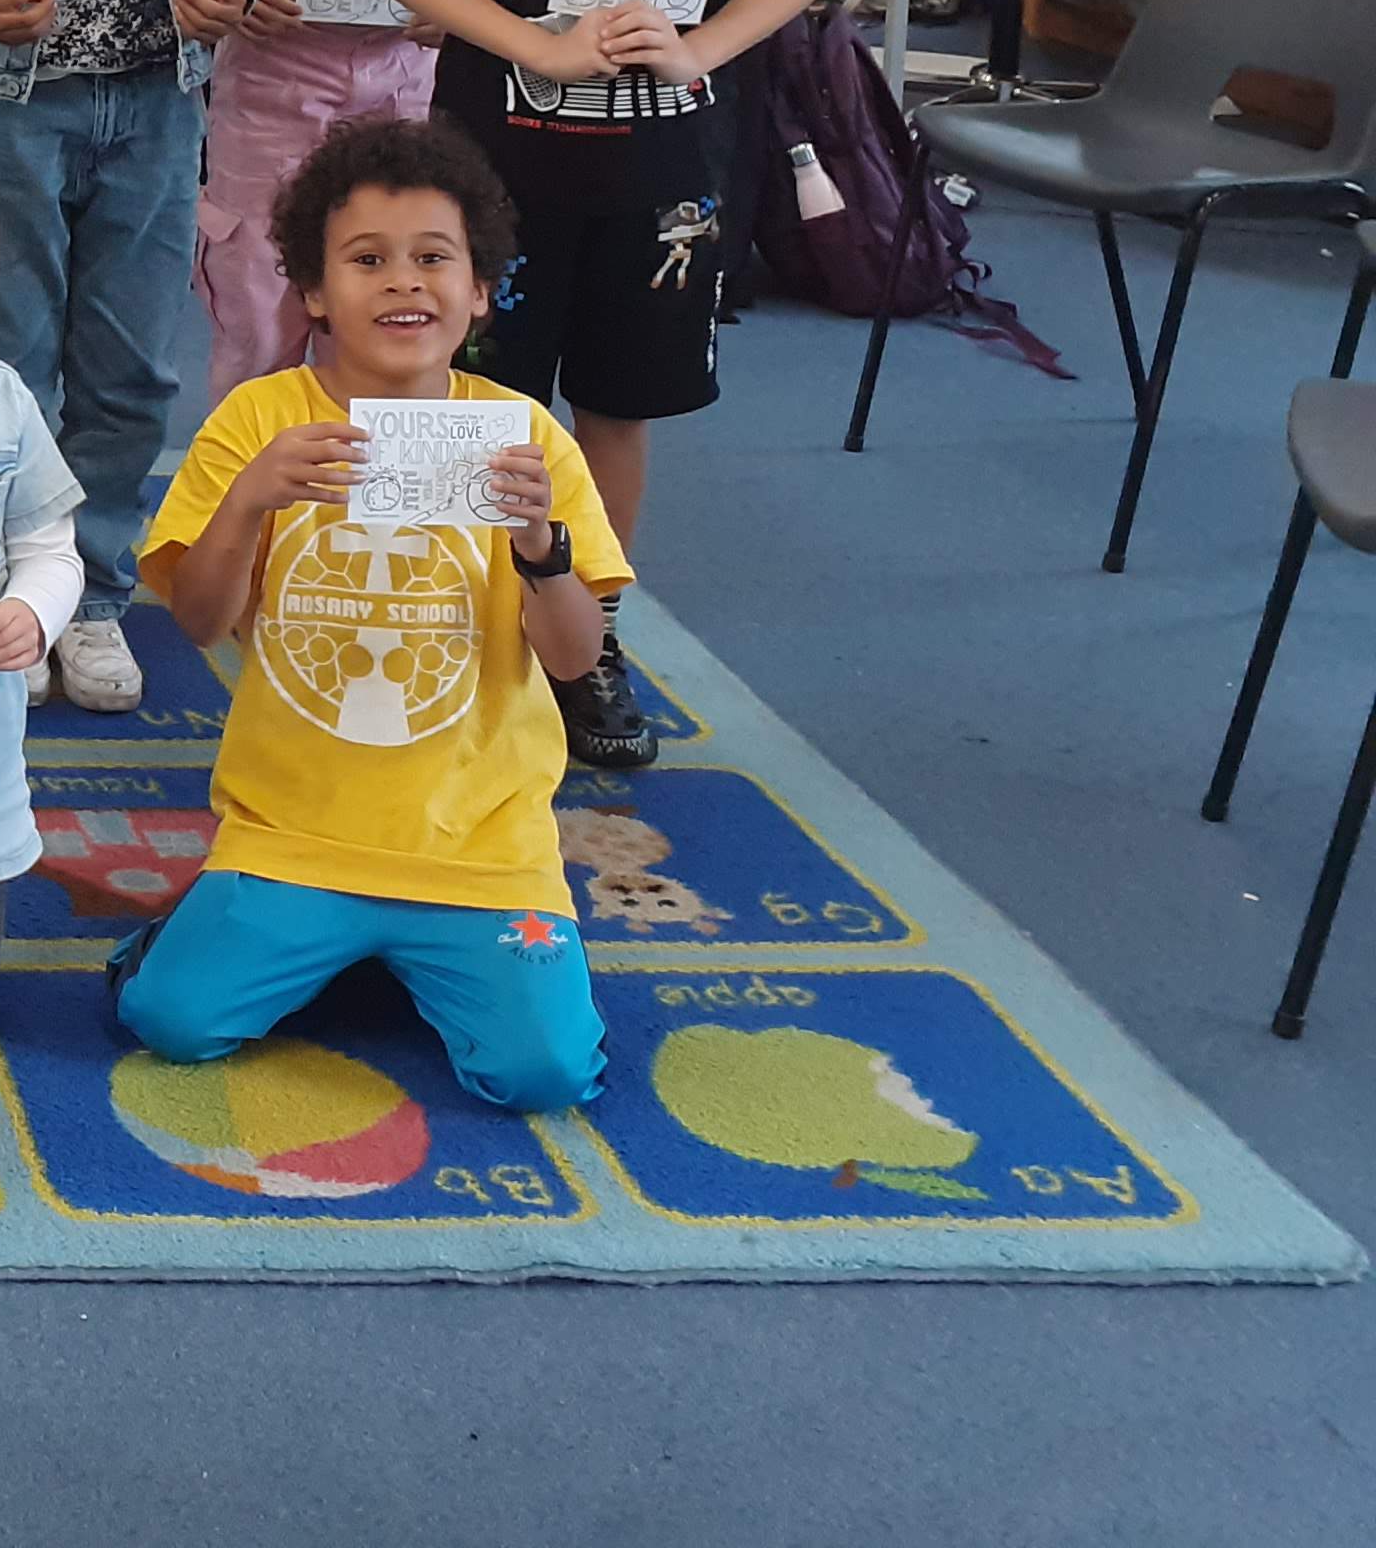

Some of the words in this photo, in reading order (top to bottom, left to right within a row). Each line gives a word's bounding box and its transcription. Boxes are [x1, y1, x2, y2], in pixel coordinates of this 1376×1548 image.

[361, 411, 449, 440] YOURS
[286, 593, 374, 620] ROSARY
[387, 603, 469, 624] SCHOOL
[653, 976, 818, 1012] apple
[433, 1162, 554, 1208] Bb
[1010, 1163, 1137, 1206] Aa
